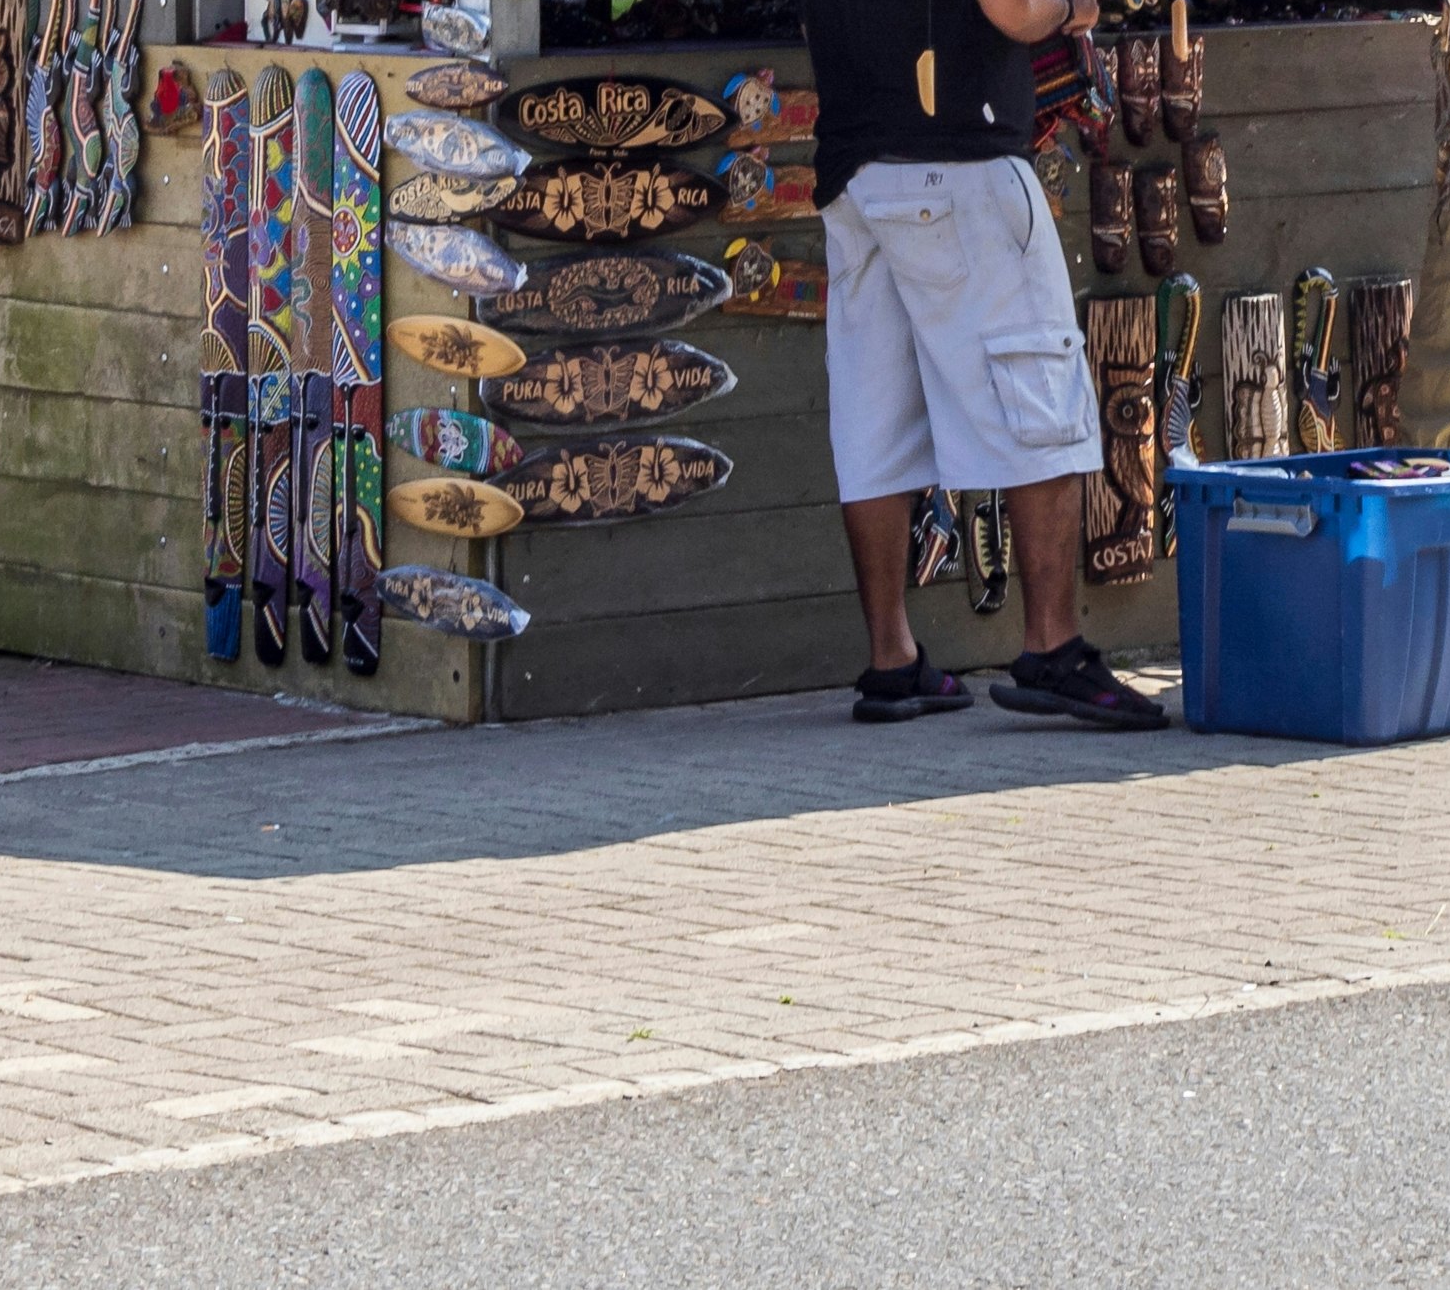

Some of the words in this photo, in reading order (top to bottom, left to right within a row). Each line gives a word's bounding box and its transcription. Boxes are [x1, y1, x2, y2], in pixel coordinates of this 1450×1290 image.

[520, 88, 584, 129] Costa
[598, 82, 649, 116] Rica
[501, 190, 541, 210] OSTA
[677, 188, 708, 206] RICA
[496, 291, 543, 314] COSTA
[666, 276, 700, 295] RICA
[503, 380, 543, 402] PURA
[673, 366, 712, 389] VIDA
[682, 460, 715, 479] VIDA
[1093, 538, 1147, 571] COSTA
[385, 577, 411, 598] PURA
[486, 607, 510, 625] VIDA
